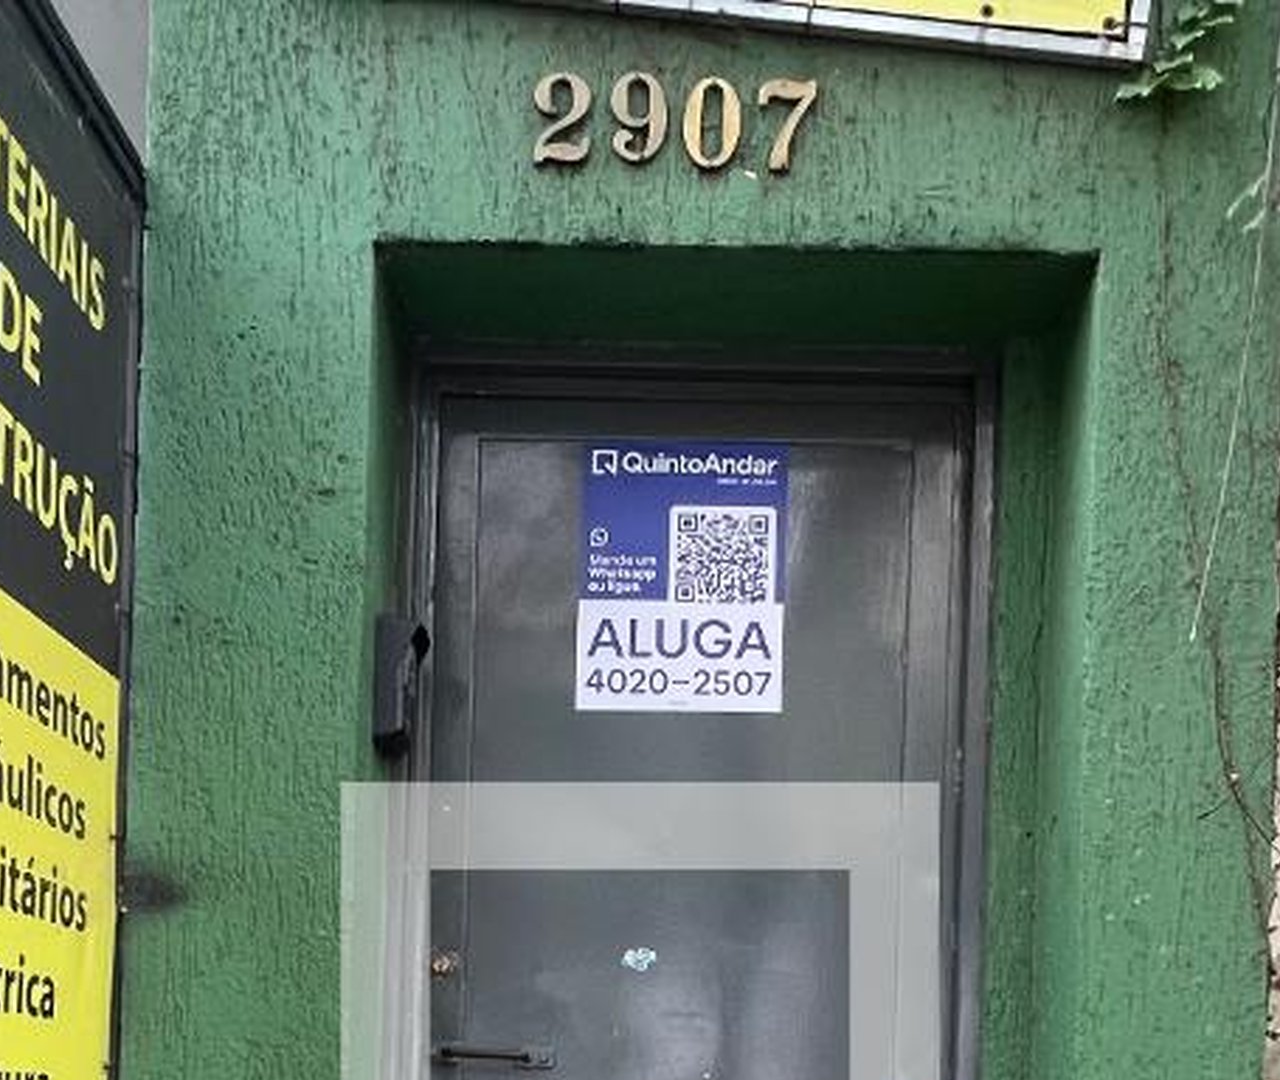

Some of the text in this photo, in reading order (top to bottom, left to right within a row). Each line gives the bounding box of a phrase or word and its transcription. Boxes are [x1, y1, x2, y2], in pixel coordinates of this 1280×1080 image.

[533, 71, 818, 172] 2907
[622, 451, 779, 476] QuintoAndar
[587, 618, 773, 660] ALUGA
[585, 668, 772, 697] 4020-2507
